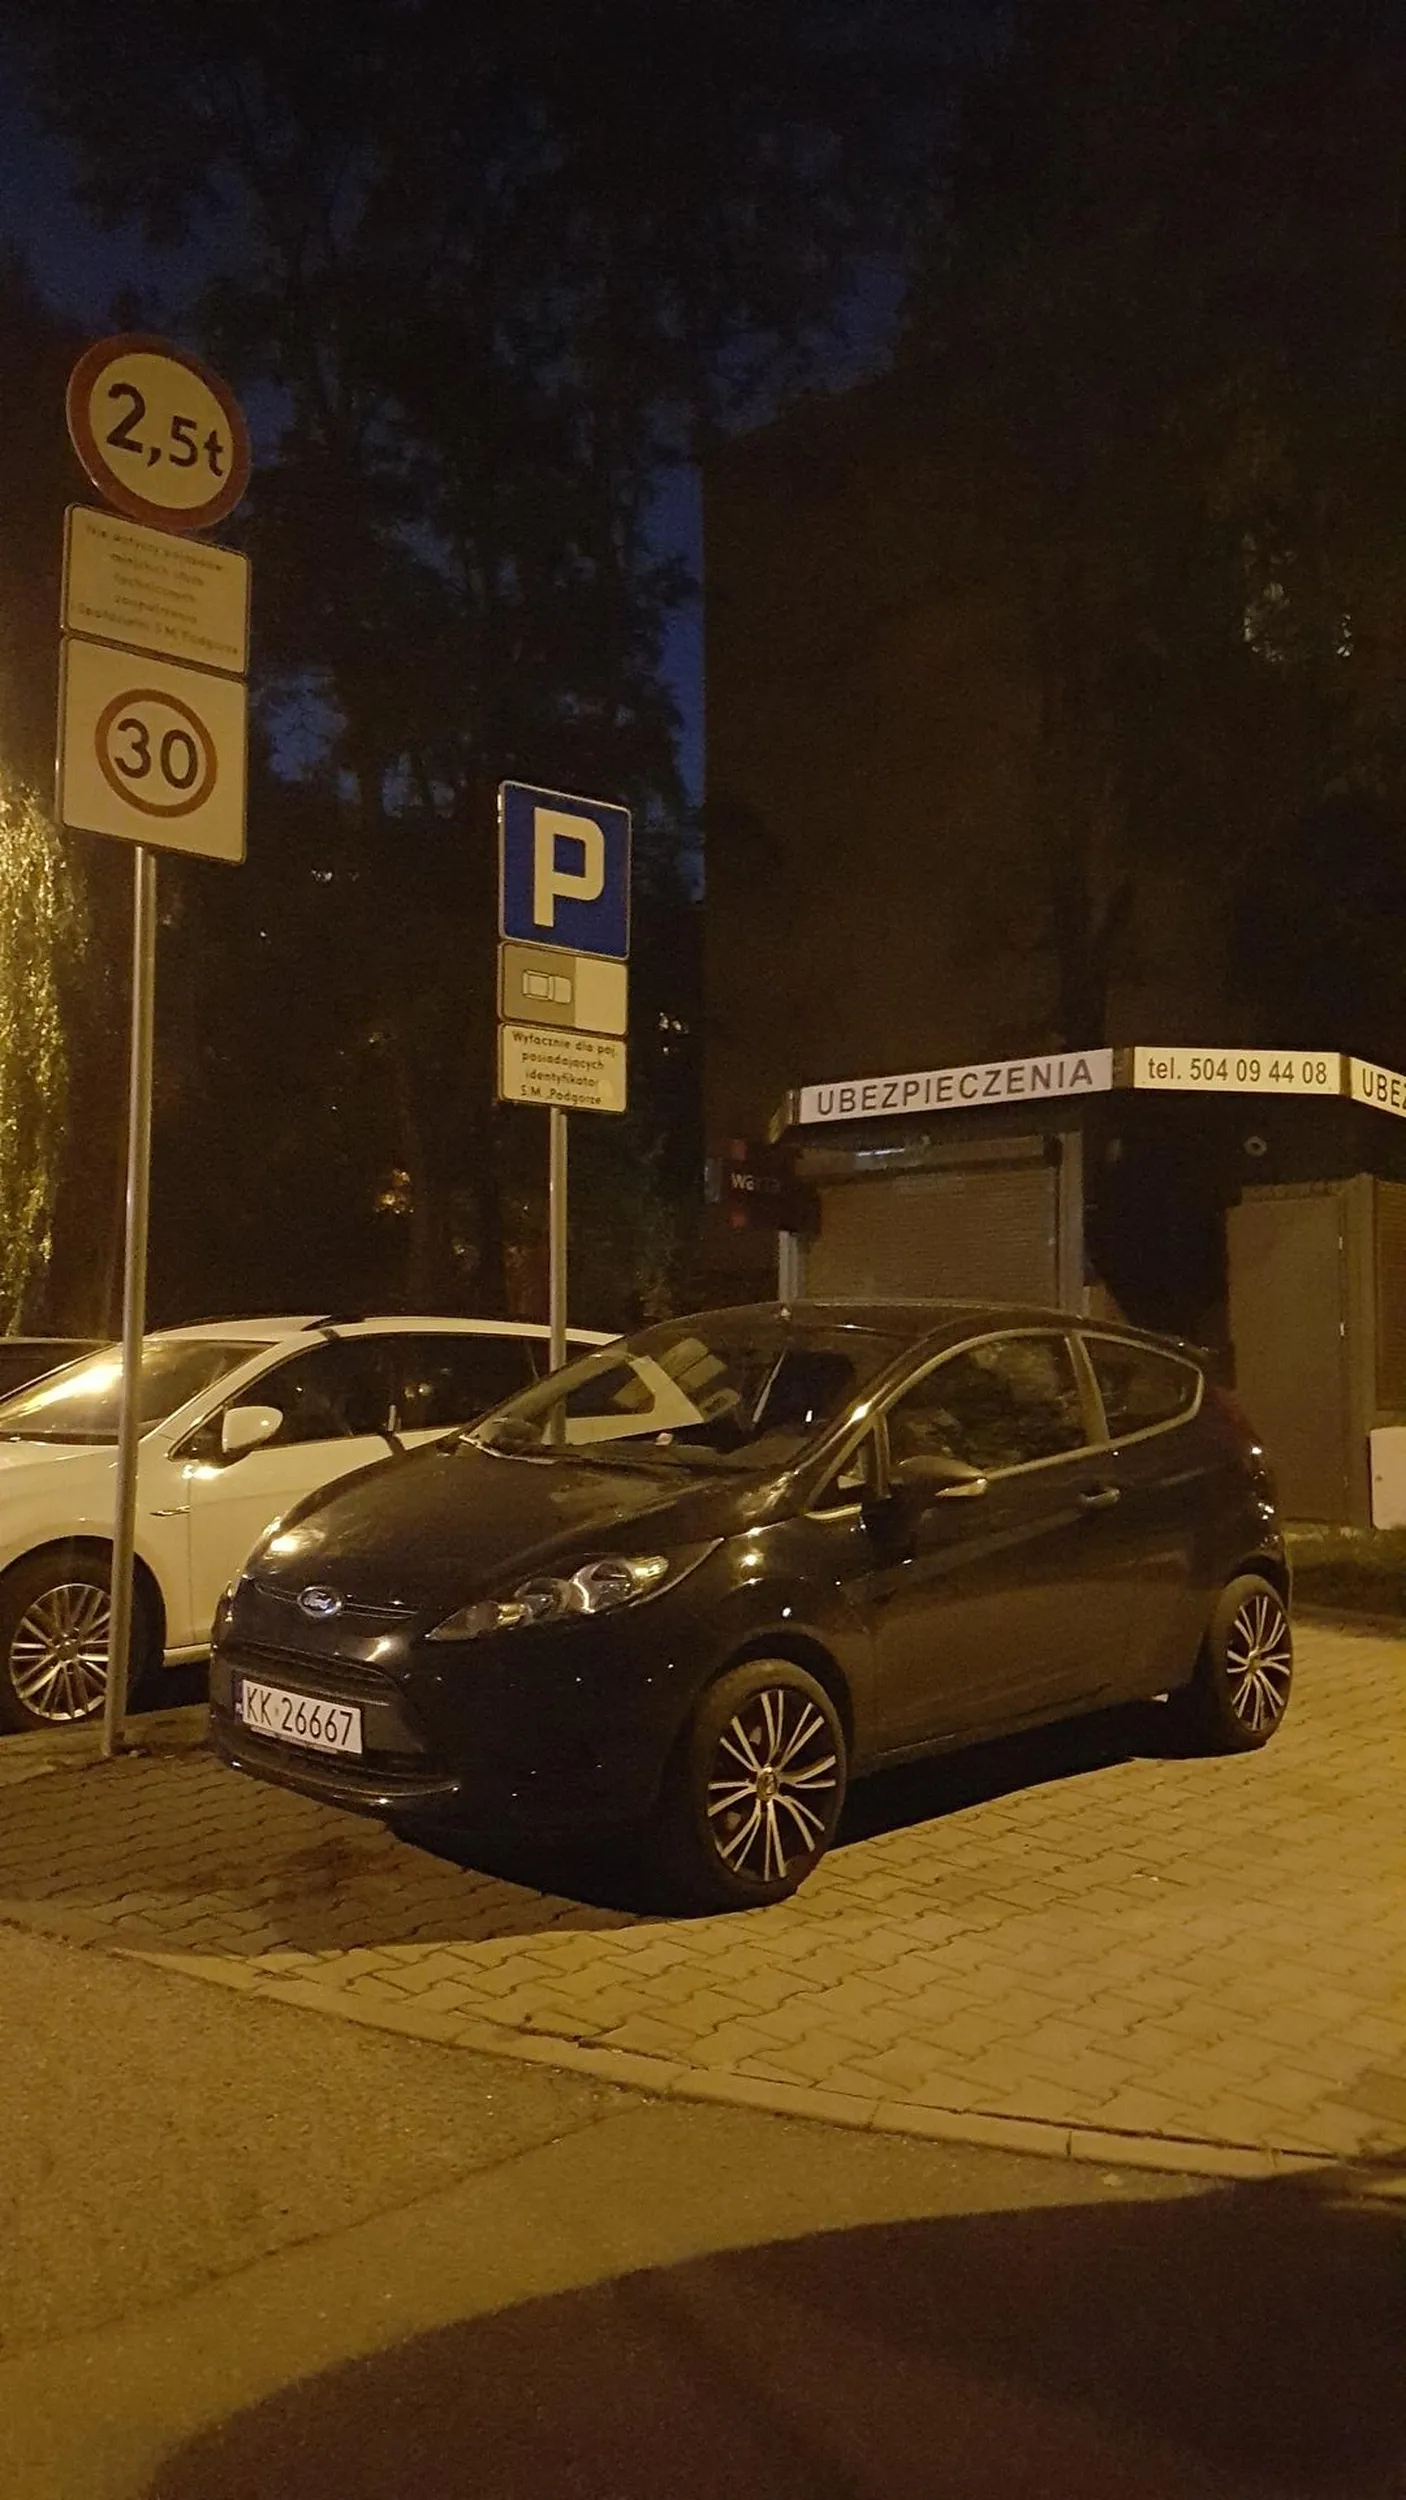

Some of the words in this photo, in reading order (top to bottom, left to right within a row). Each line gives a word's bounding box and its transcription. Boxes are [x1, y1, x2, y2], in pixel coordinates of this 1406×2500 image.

[106, 382, 224, 478] 2,5t
[114, 717, 198, 790] 30
[532, 806, 606, 928] P
[575, 1041, 594, 1053] dla
[1148, 1057, 1182, 1080] tel.
[1189, 1058, 1228, 1081] 504
[1236, 1059, 1261, 1083] 09
[1268, 1060, 1294, 1084] 44
[1302, 1061, 1327, 1085] 08
[817, 1058, 1093, 1116] UBEZPIECZENIA
[246, 1686, 272, 1727] KK
[281, 1696, 353, 1746] 26667
